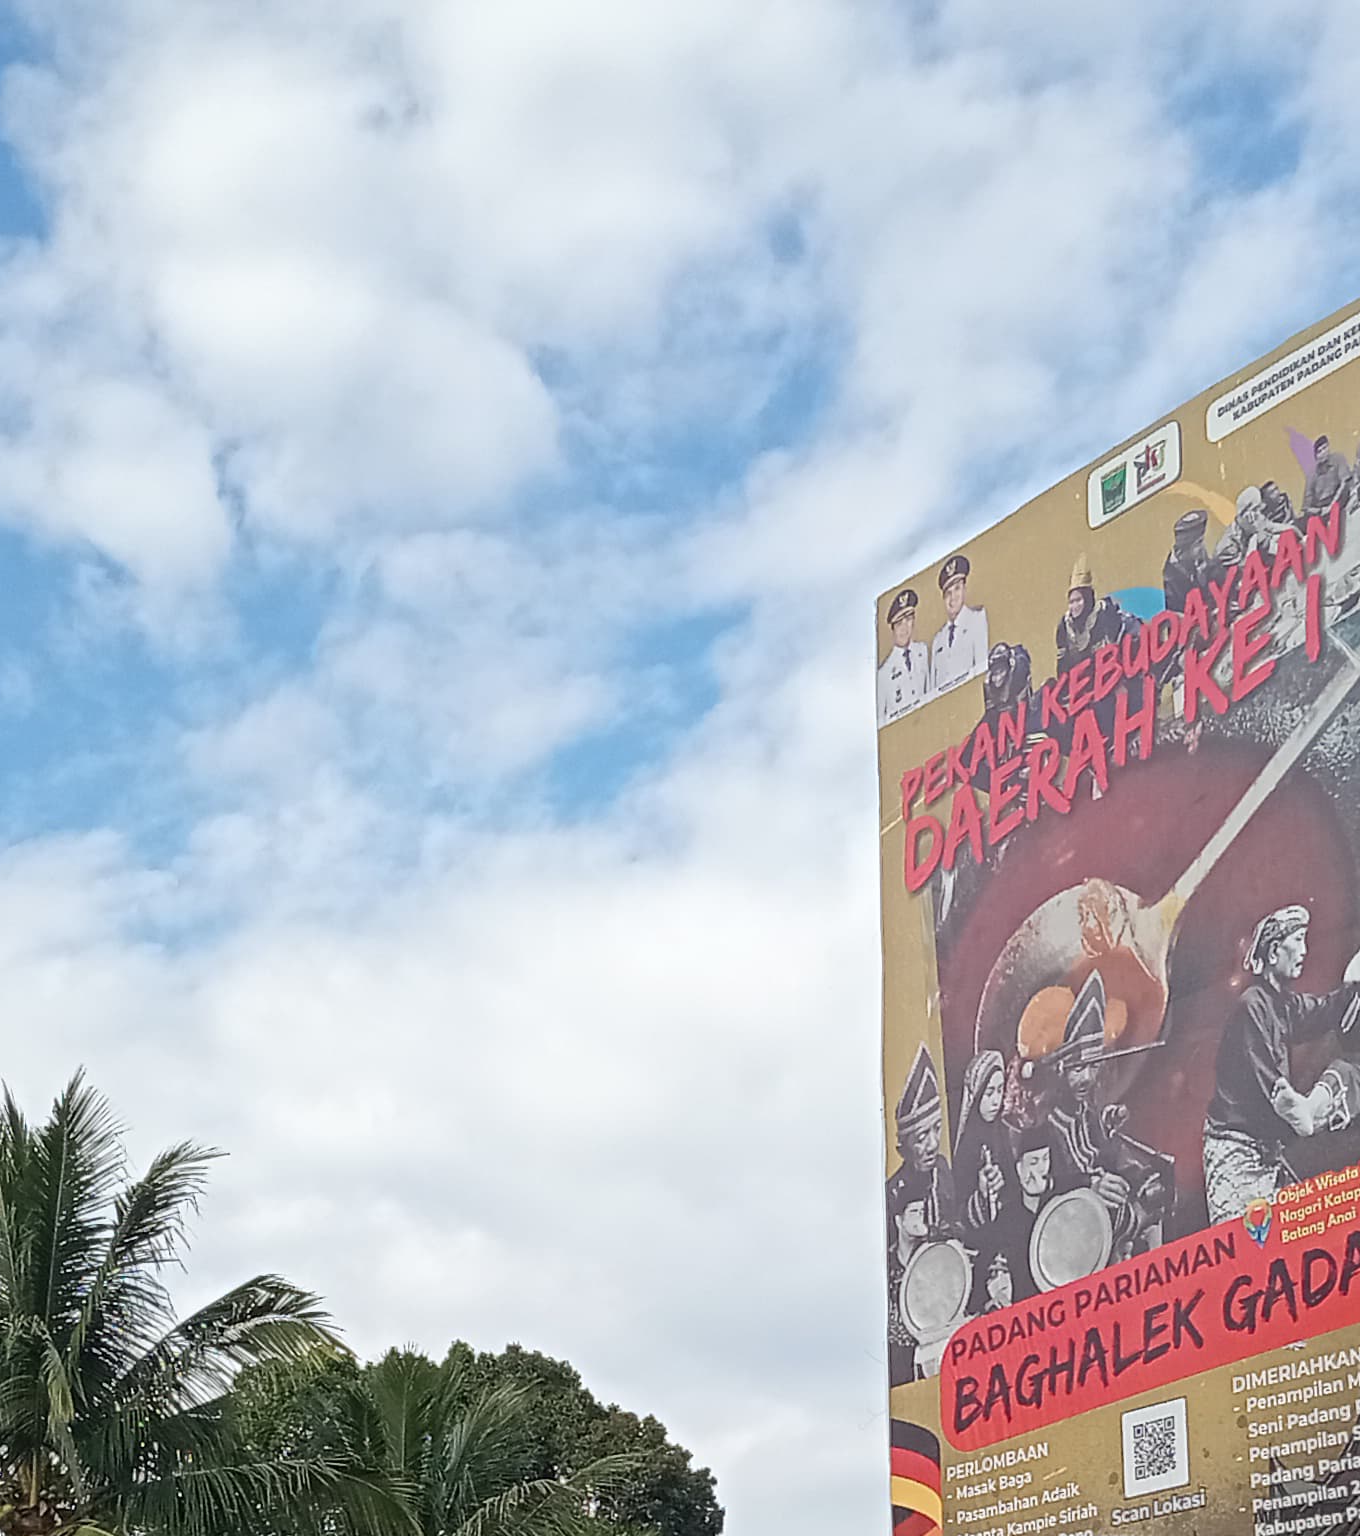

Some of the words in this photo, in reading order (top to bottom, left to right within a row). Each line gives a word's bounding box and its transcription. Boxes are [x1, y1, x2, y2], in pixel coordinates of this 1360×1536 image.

[1217, 391, 1249, 418] DINAS
[1251, 350, 1315, 397] PENDIDIKAN
[1317, 335, 1341, 356] DAN
[1232, 377, 1295, 421] KABUPATEN
[1297, 348, 1342, 381] PADANG
[900, 700, 1027, 820] PEKAN
[1041, 500, 1340, 725] KEBUDAYAAN
[904, 675, 1155, 893] DAERAH
[1184, 600, 1277, 726] KE
[1304, 573, 1322, 664] I
[1277, 1181, 1314, 1205] Objek
[1315, 1166, 1359, 1190] Wisata
[1279, 1203, 1322, 1225] Nagari
[1280, 1221, 1325, 1243] Batang
[1327, 1207, 1357, 1228] Anai
[949, 1300, 1066, 1367] PADANG
[1075, 1232, 1237, 1320] PARIAMAN
[954, 1289, 1206, 1434] BAGHALEK
[1246, 1377, 1344, 1413] Penampilan
[1247, 1416, 1284, 1438] Seni
[1287, 1403, 1351, 1431] Padang
[946, 1442, 1049, 1482] PERLOMBAAN
[1249, 1427, 1349, 1463] Penampilan
[956, 1478, 996, 1500] Masak
[999, 1472, 1032, 1491] Baga
[1250, 1461, 1315, 1489] Padang
[957, 1495, 1038, 1524] Pasambahan
[1041, 1483, 1080, 1505] Adaik
[1112, 1506, 1150, 1526] Scan
[1153, 1488, 1206, 1517] Lokasi
[1252, 1481, 1348, 1514] Penampilan
[1007, 1514, 1057, 1536] Kampie
[1059, 1503, 1098, 1524] Siriah
